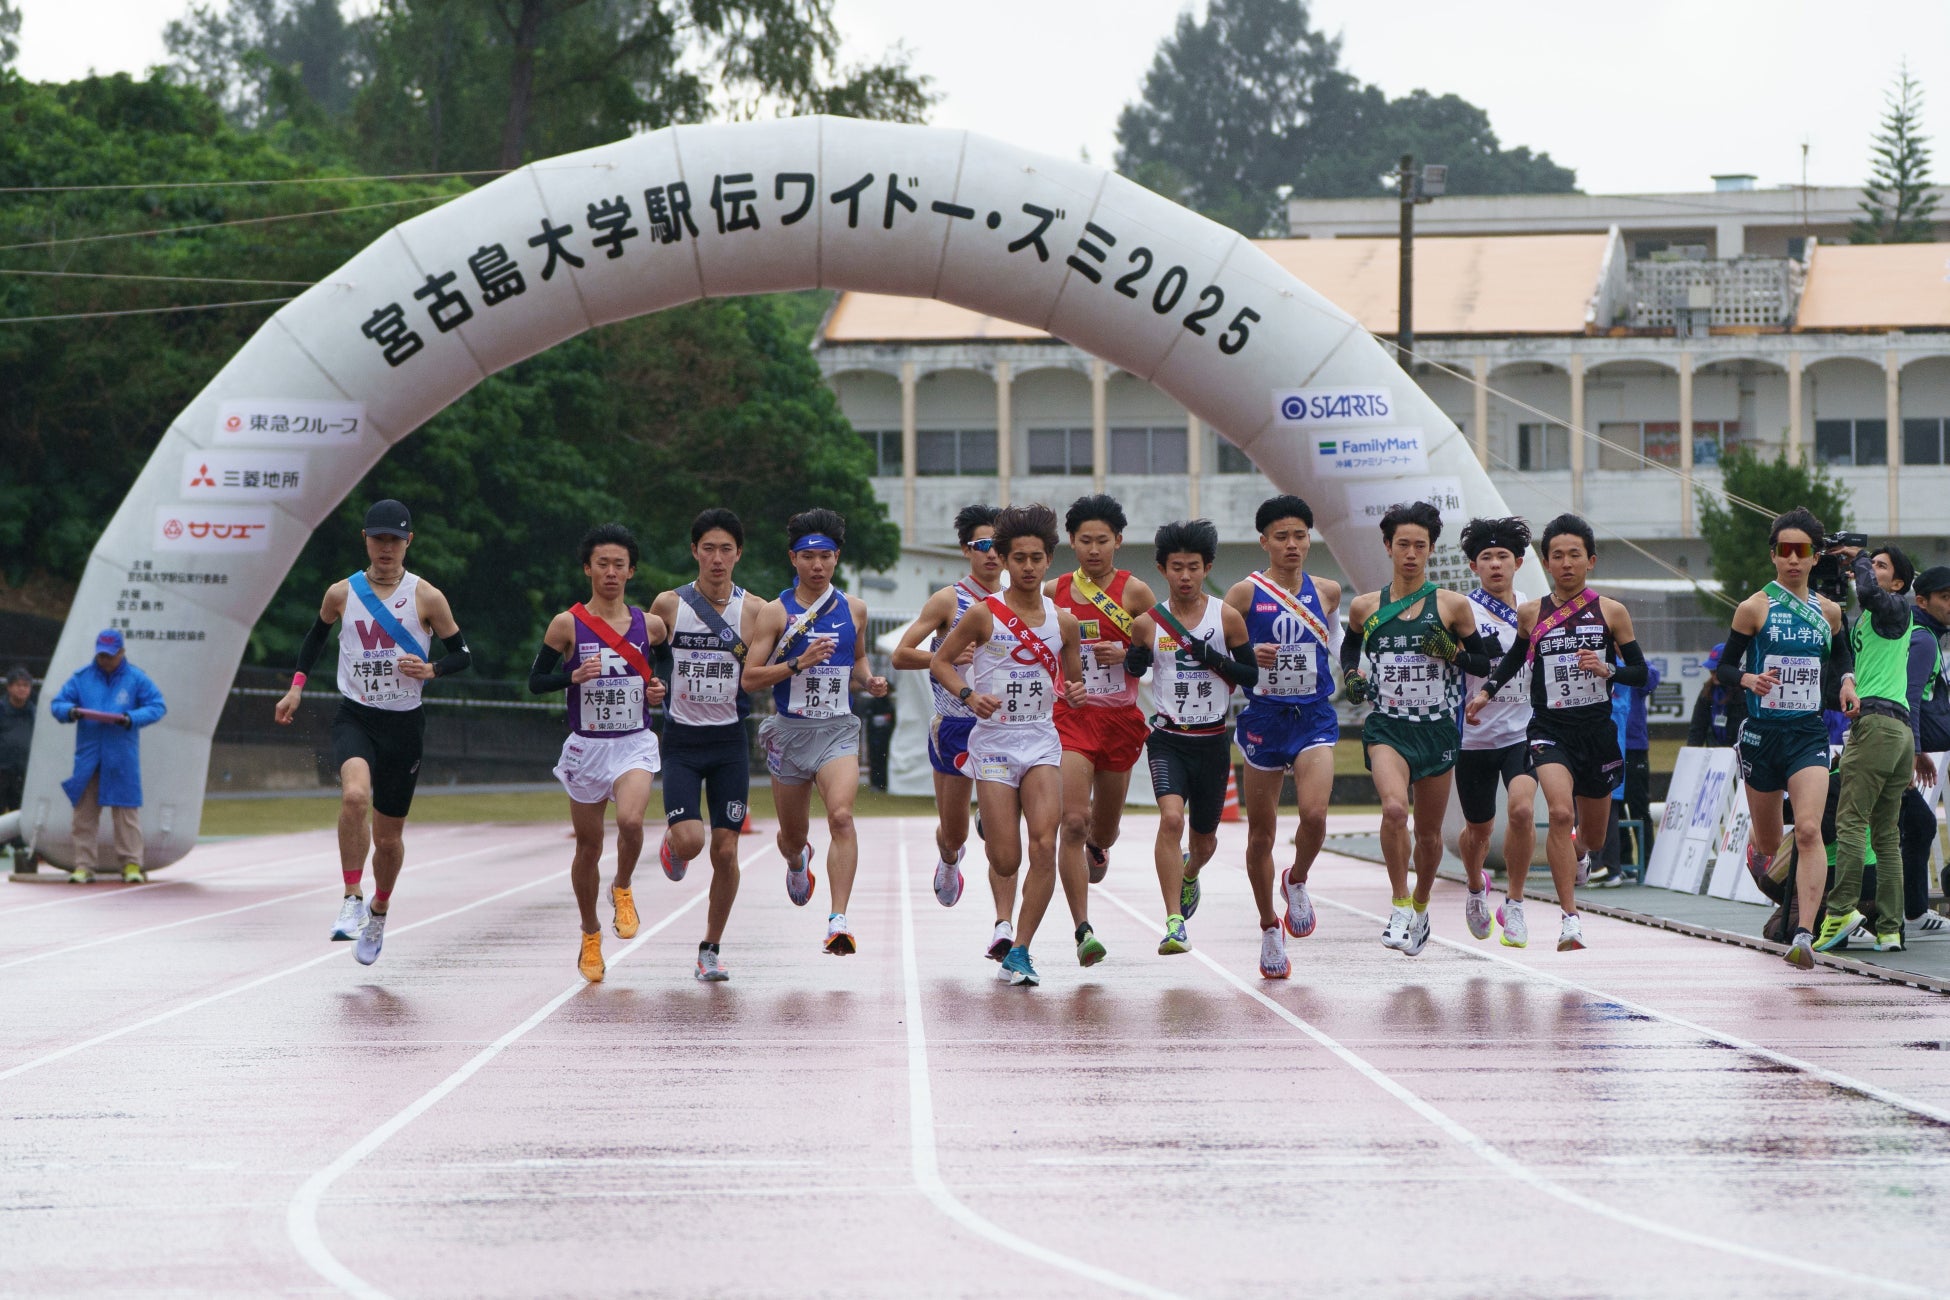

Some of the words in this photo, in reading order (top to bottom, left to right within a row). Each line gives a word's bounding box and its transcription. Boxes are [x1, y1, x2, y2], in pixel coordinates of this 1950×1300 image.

[1310, 394, 1388, 419] STARTS
[1342, 438, 1418, 454] FamilyMart
[1336, 456, 1410, 469] 沖縄ファミリーマート
[223, 470, 299, 489] 三菱地所
[188, 521, 265, 539] サンエー
[116, 601, 164, 611] 宮古島市
[1540, 634, 1603, 654] 国学院大学
[1767, 625, 1824, 645] 青山学院
[371, 649, 397, 658] STARTS
[1402, 655, 1427, 663] STARTS
[353, 660, 393, 678] 大学連合
[678, 661, 734, 679] 東京国際
[816, 666, 841, 675] STARTS
[1018, 670, 1040, 678] STARTS
[1383, 664, 1439, 682] 芝浦工業
[805, 676, 841, 695] 東海
[1006, 680, 1043, 698] 中央
[1174, 681, 1212, 699] 専修
